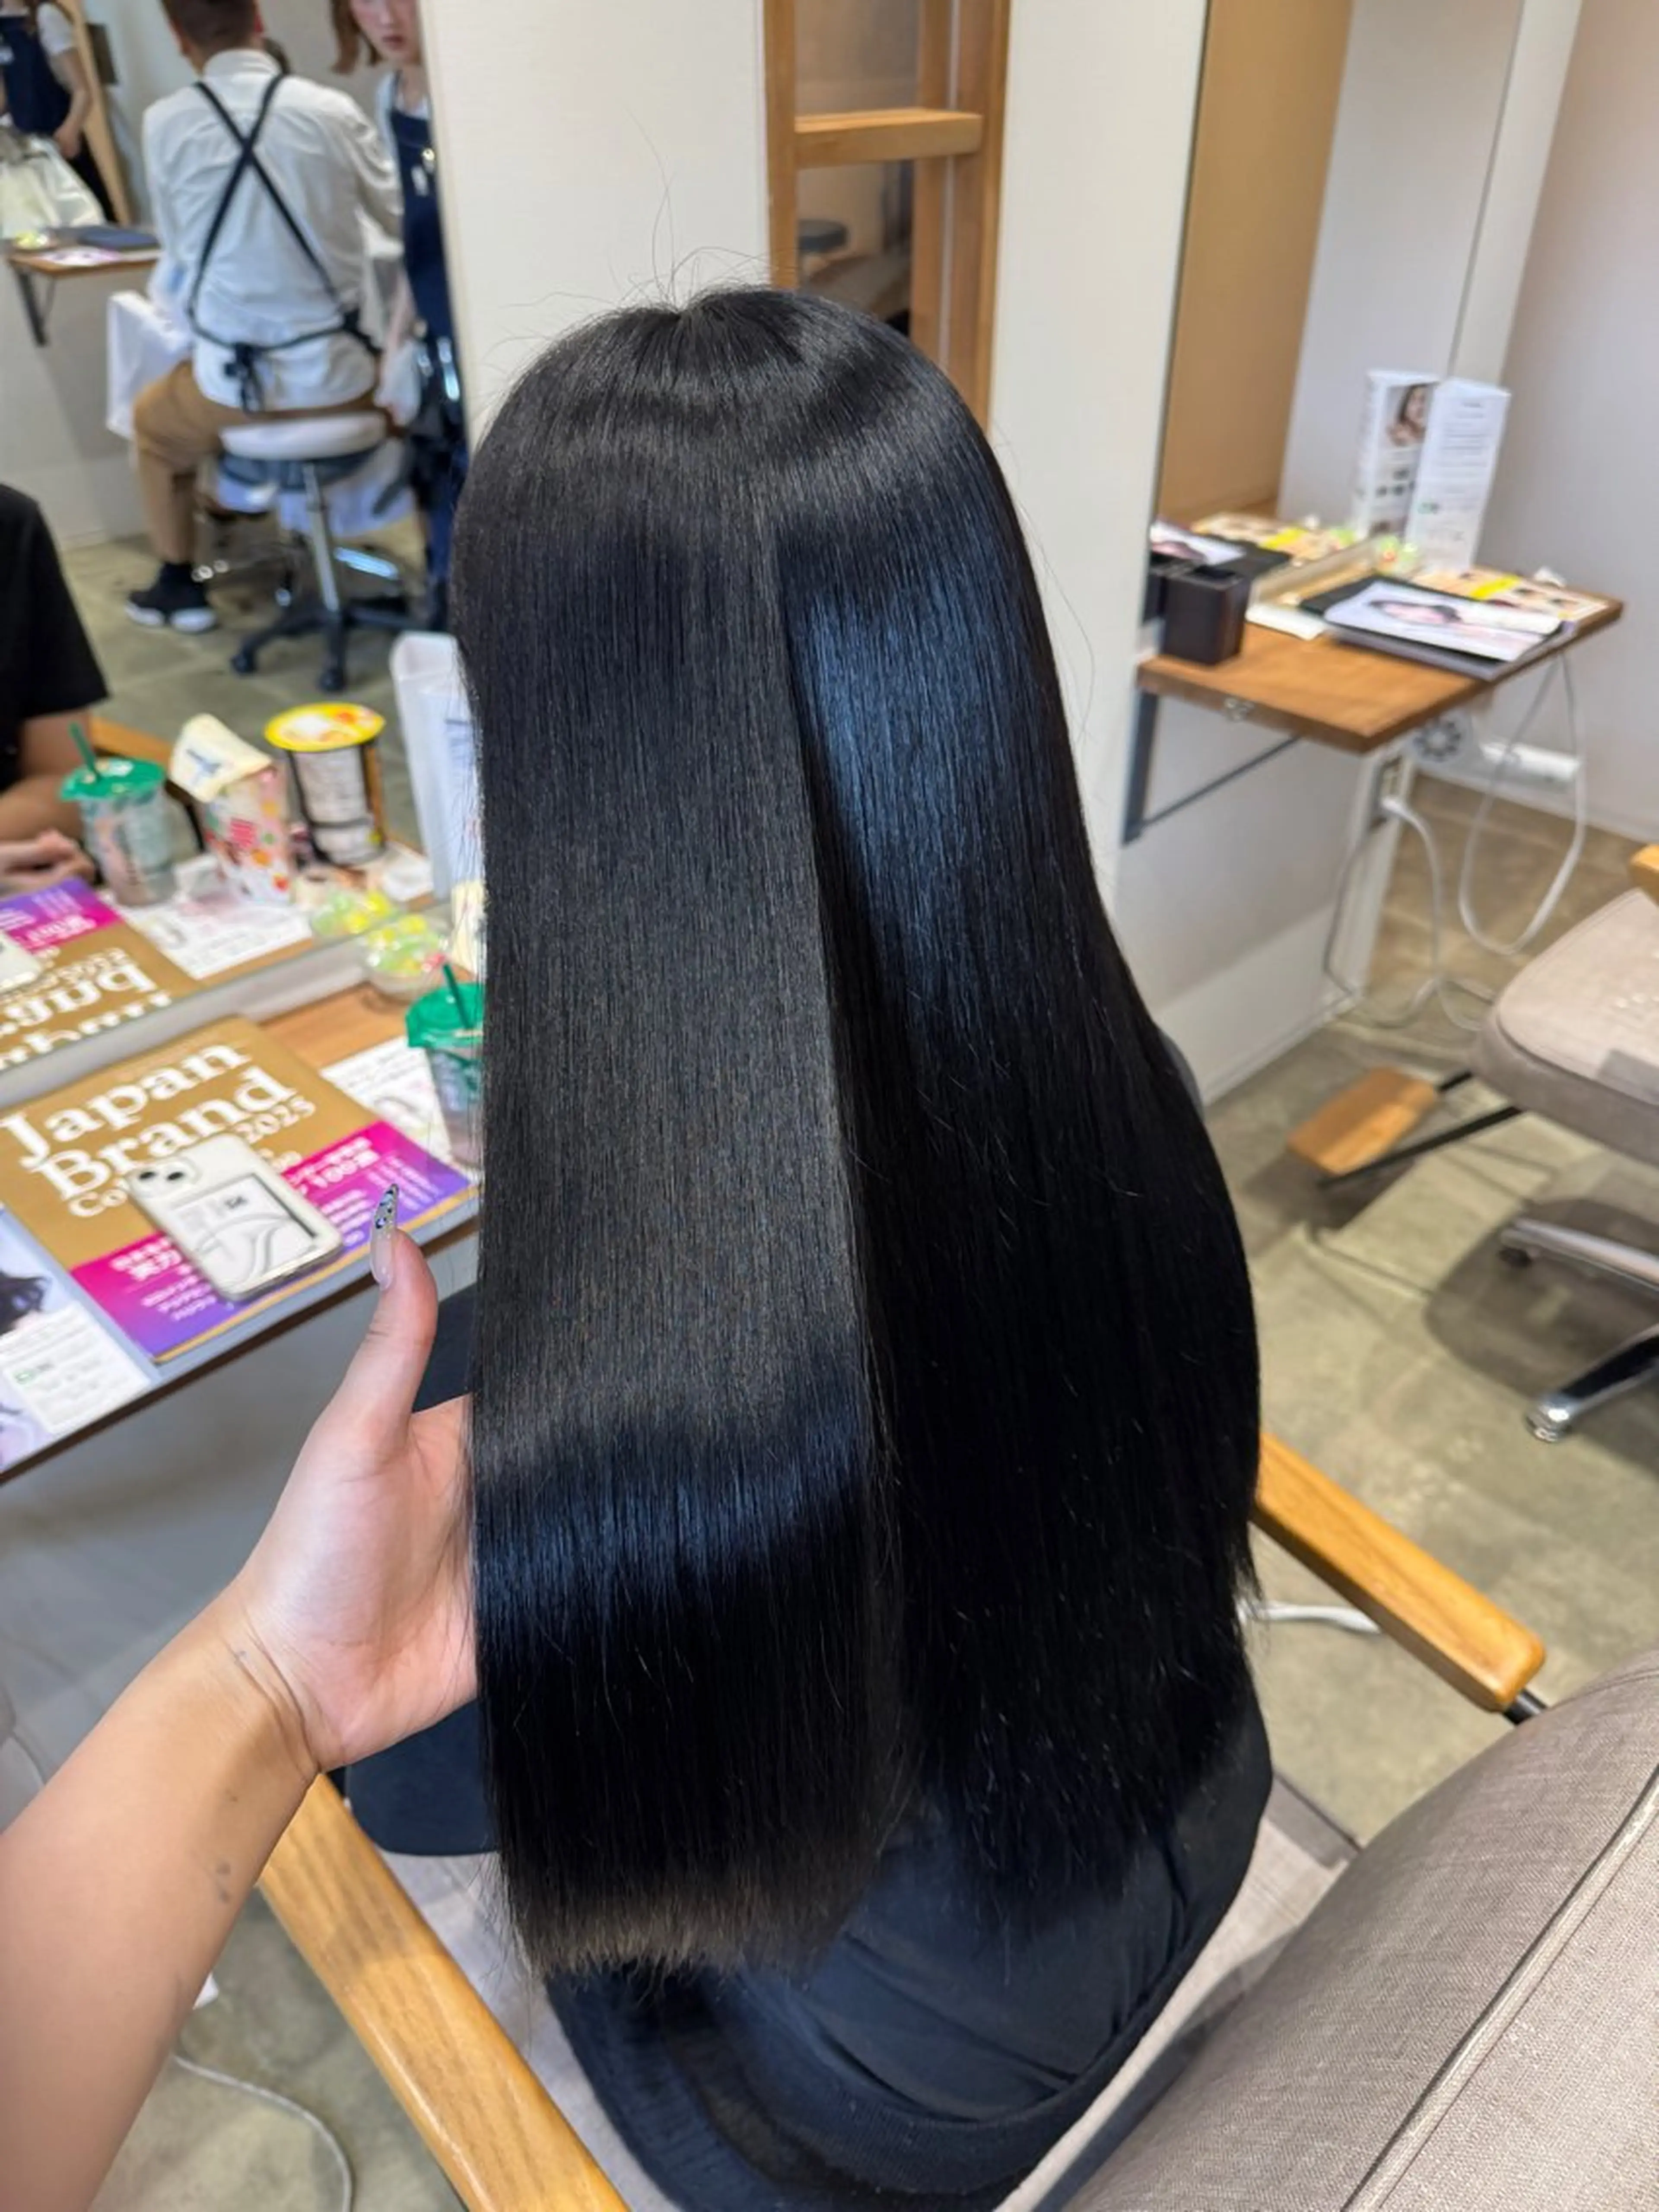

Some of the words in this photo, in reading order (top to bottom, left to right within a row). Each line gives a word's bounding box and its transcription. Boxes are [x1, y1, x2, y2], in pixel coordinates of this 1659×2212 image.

[0, 1045, 251, 1168] Japan
[28, 1065, 298, 1202] Brand
[236, 1096, 316, 1144] 2025
